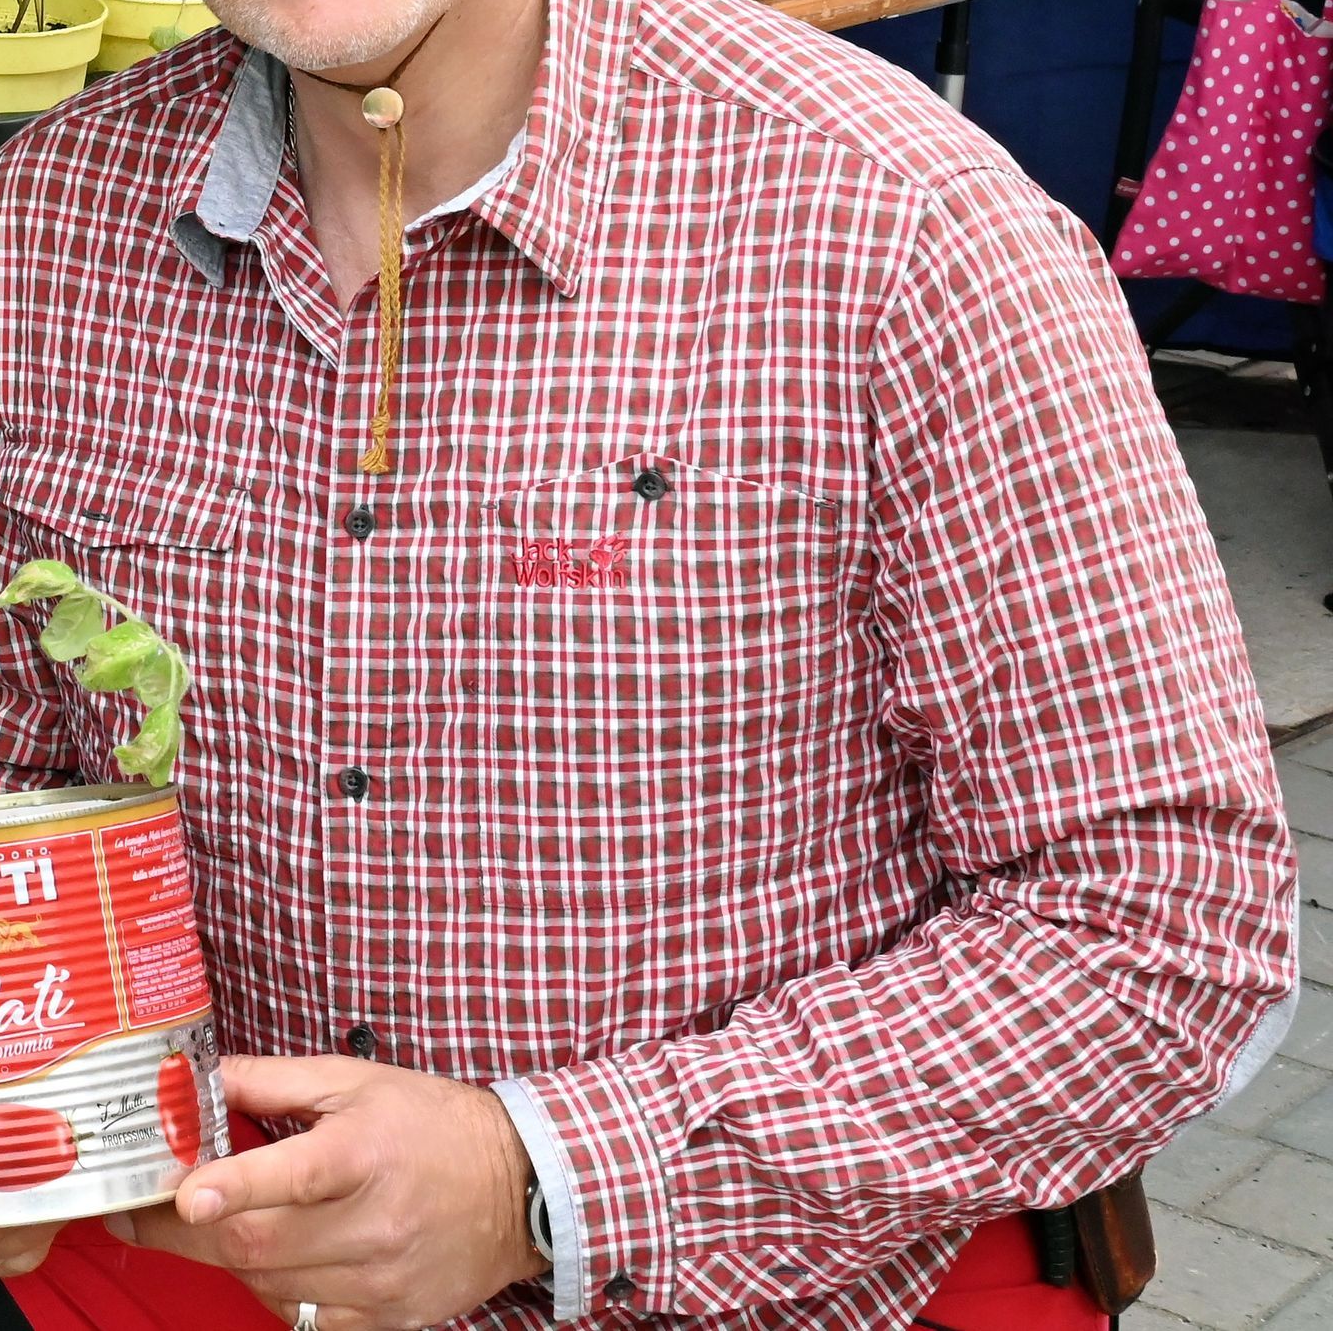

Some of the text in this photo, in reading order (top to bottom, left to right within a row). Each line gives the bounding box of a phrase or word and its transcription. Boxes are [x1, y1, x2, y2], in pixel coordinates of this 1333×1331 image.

[511, 536, 573, 562] Jack
[513, 561, 625, 588] Wolfskin
[101, 1125, 160, 1148] PROFESSIONAL
